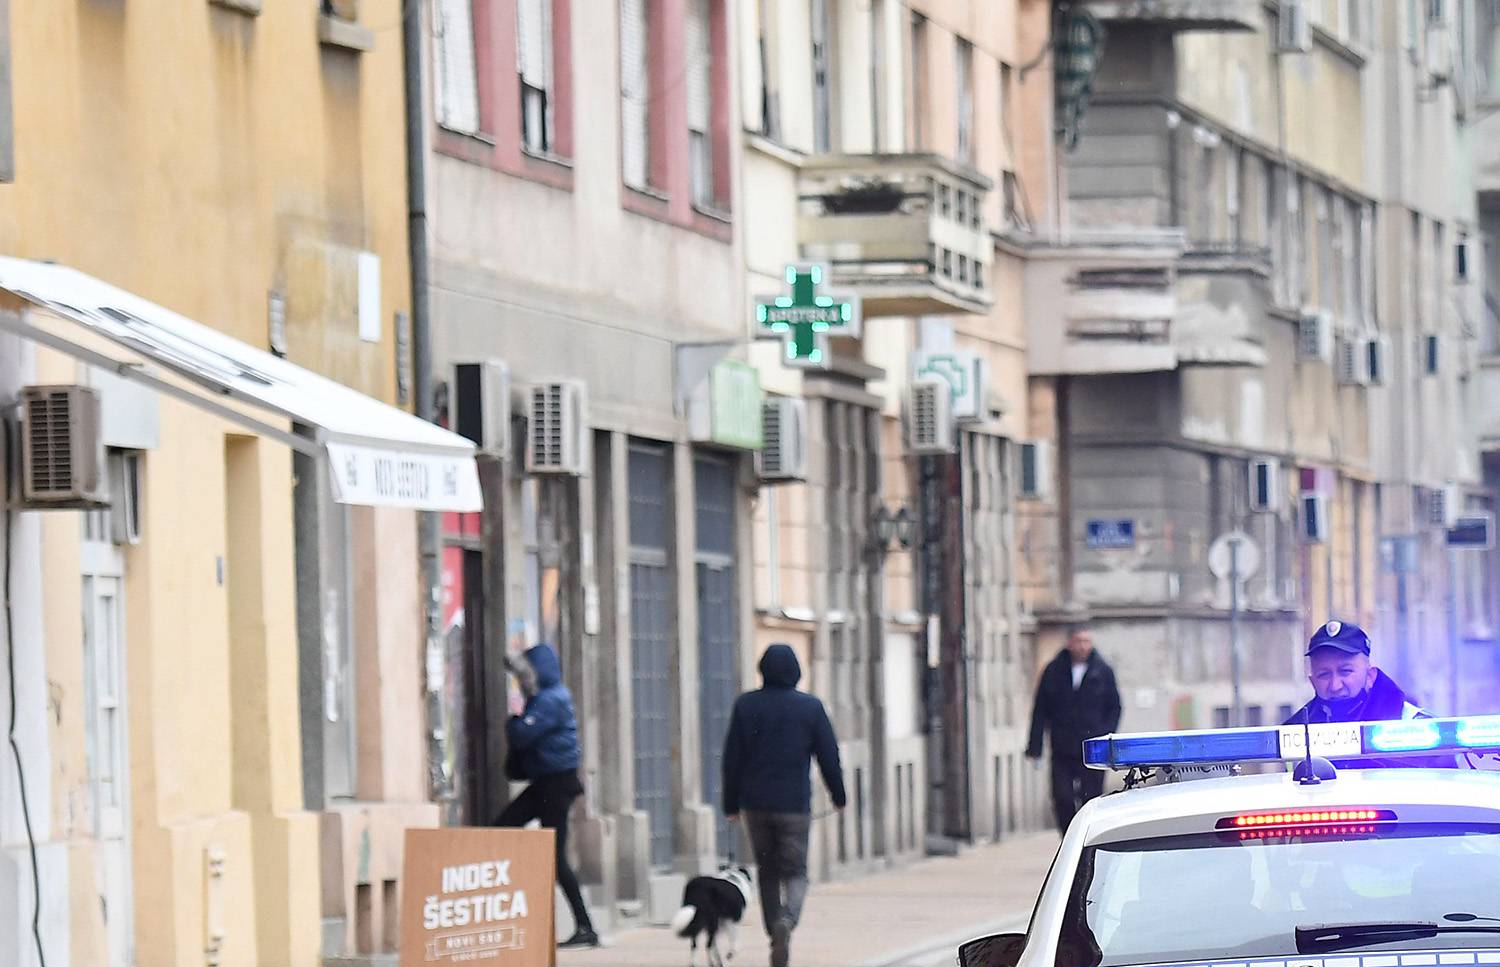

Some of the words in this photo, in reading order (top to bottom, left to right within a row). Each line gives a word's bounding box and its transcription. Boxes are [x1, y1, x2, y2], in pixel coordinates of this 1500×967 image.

[1283, 729, 1359, 748] ПОИЦИЈА
[442, 860, 511, 893] INDEX
[423, 889, 529, 930] ŠESTICA
